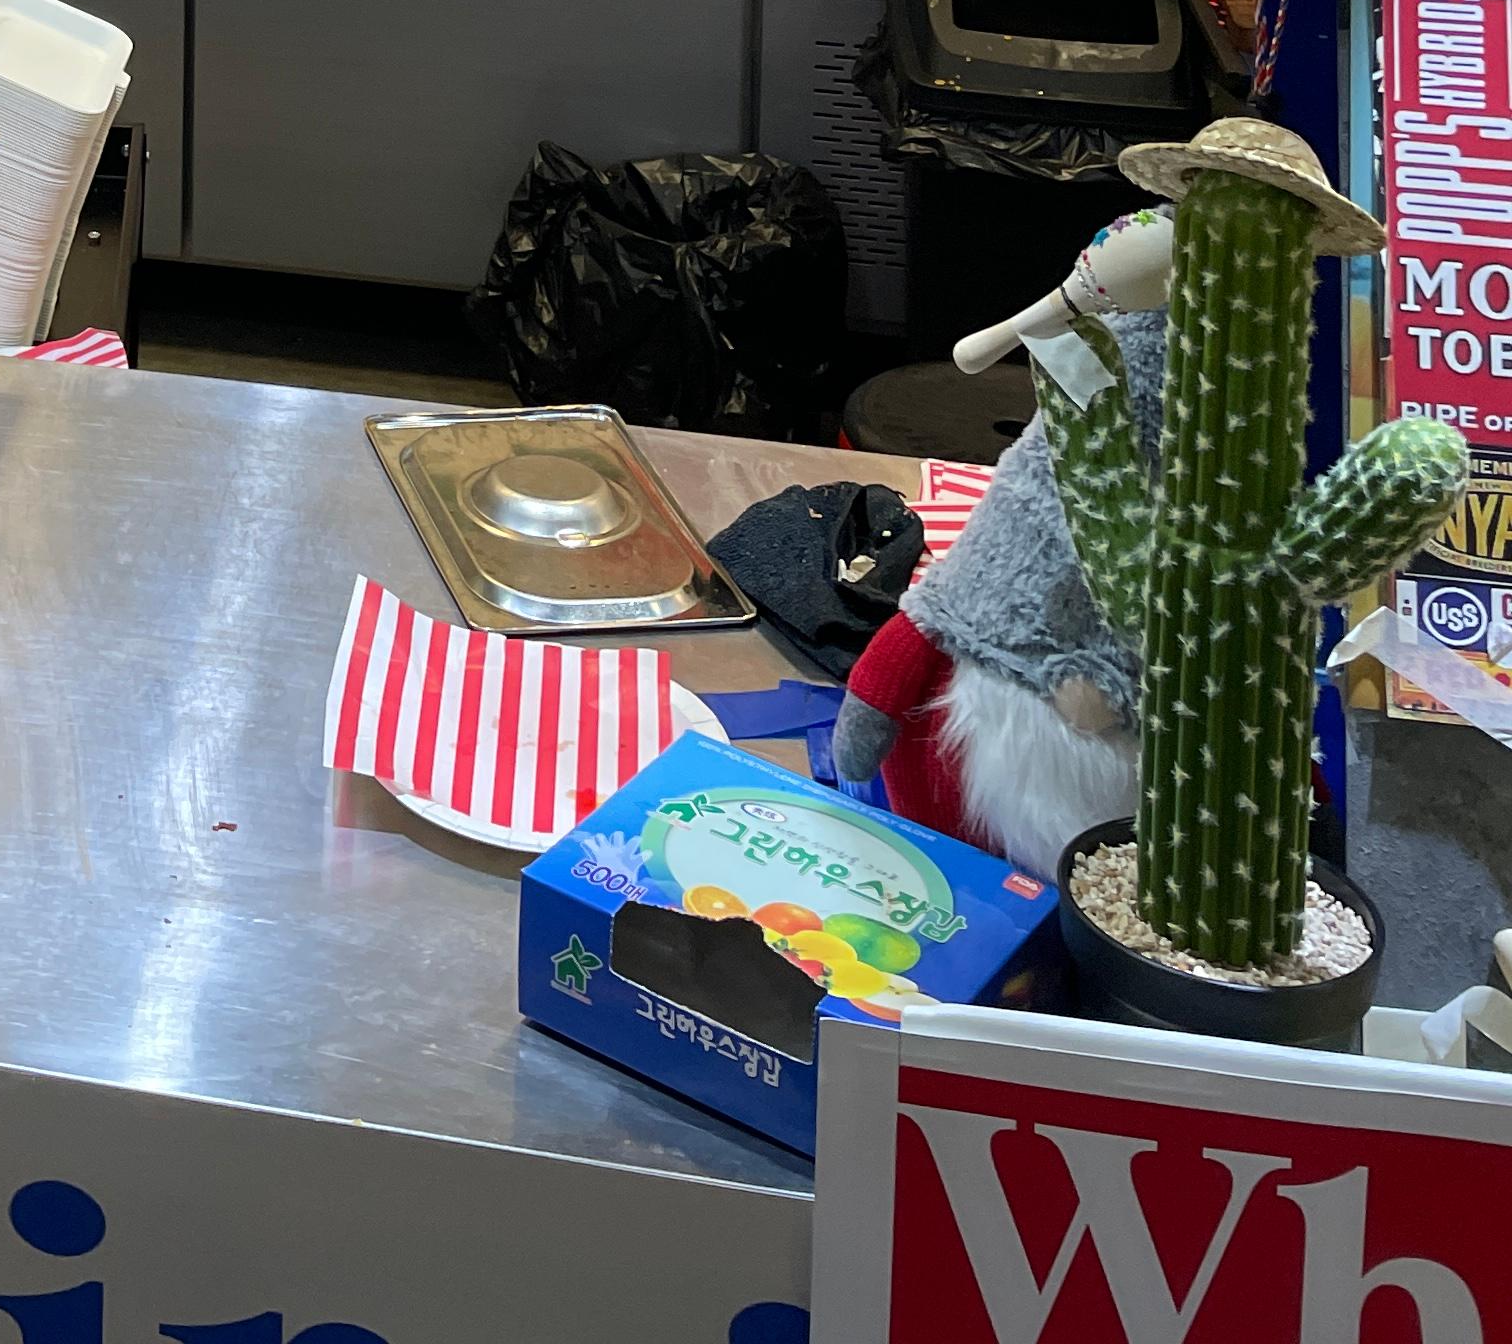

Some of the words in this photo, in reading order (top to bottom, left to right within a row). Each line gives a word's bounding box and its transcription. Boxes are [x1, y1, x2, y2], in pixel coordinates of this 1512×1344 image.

[1399, 257, 1512, 320] MO
[1400, 400, 1480, 429] PIPE
[1431, 602, 1481, 631] USS
[570, 858, 649, 903] 500매
[709, 814, 969, 945] 그린하우스장갑
[635, 994, 783, 1089] 그린하우스장갑
[899, 1102, 1488, 1344] Wh
